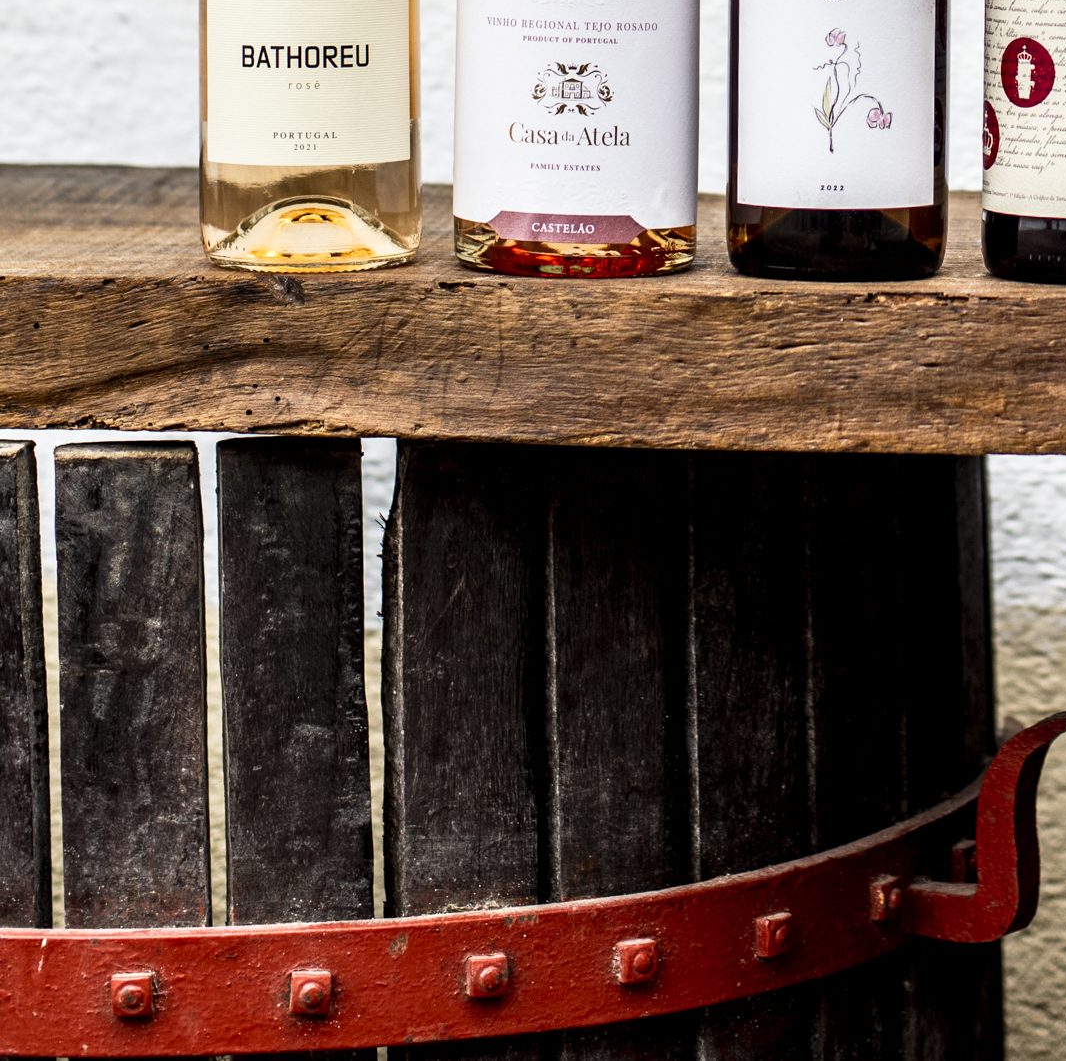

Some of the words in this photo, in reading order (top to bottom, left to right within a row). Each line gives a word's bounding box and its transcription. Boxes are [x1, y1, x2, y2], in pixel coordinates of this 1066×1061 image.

[487, 16, 517, 28] VINHO
[521, 19, 580, 31] REGIONAL
[584, 21, 612, 33] TEJO
[616, 22, 658, 32] ROSADO
[522, 35, 560, 43] PRODUCT
[562, 36, 573, 44] OF
[575, 37, 619, 45] PORTUGAL
[242, 44, 369, 68] BATHOREU
[288, 80, 321, 90] rosé
[273, 131, 338, 139] PORTUGAL
[509, 122, 558, 145] Casa
[561, 131, 575, 142] da
[577, 125, 630, 147] Atela
[293, 143, 318, 151] 2021
[530, 162, 561, 171] FAMILY
[564, 164, 601, 172] ESTATES
[532, 222, 595, 234] CASTELÃO
